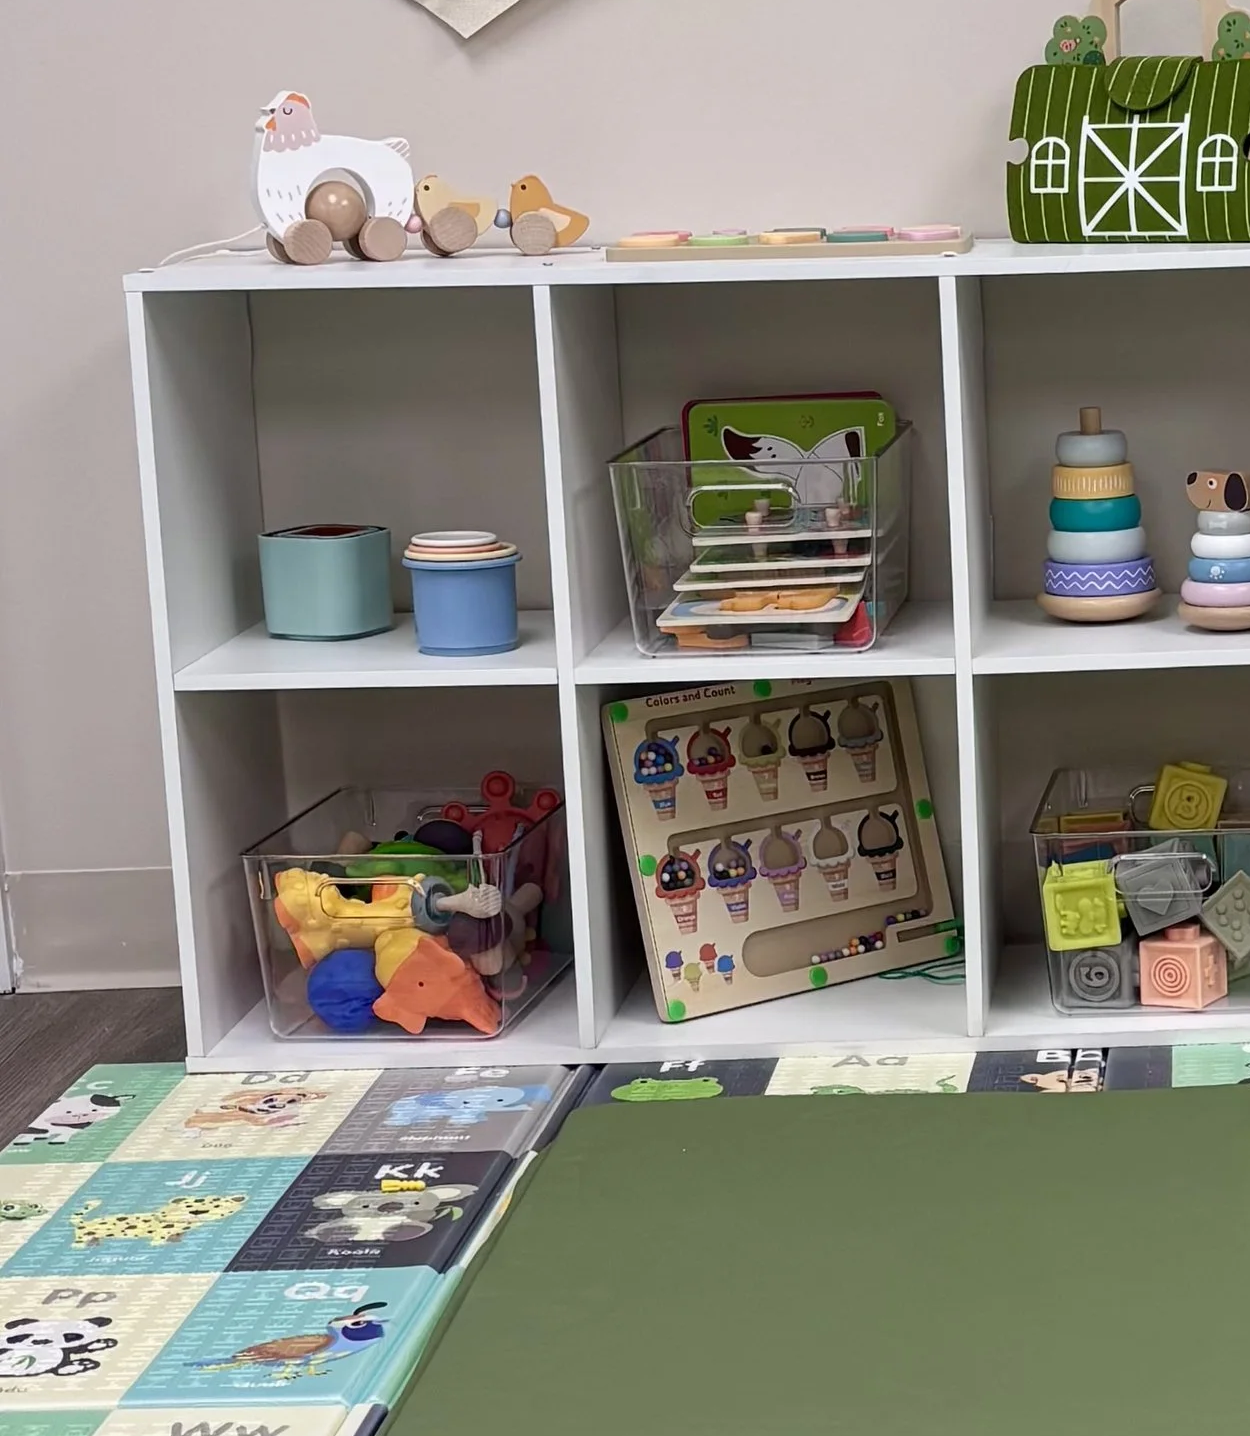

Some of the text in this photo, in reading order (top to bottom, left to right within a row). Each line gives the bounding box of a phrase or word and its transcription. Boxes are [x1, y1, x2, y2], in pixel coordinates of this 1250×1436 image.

[646, 685, 736, 708] Colors and Count
[660, 1059, 706, 1074] Ff
[831, 1053, 909, 1070] Aa
[374, 1162, 444, 1179] Kk
[41, 1288, 117, 1309] Pp
[284, 1281, 370, 1303] Qq
